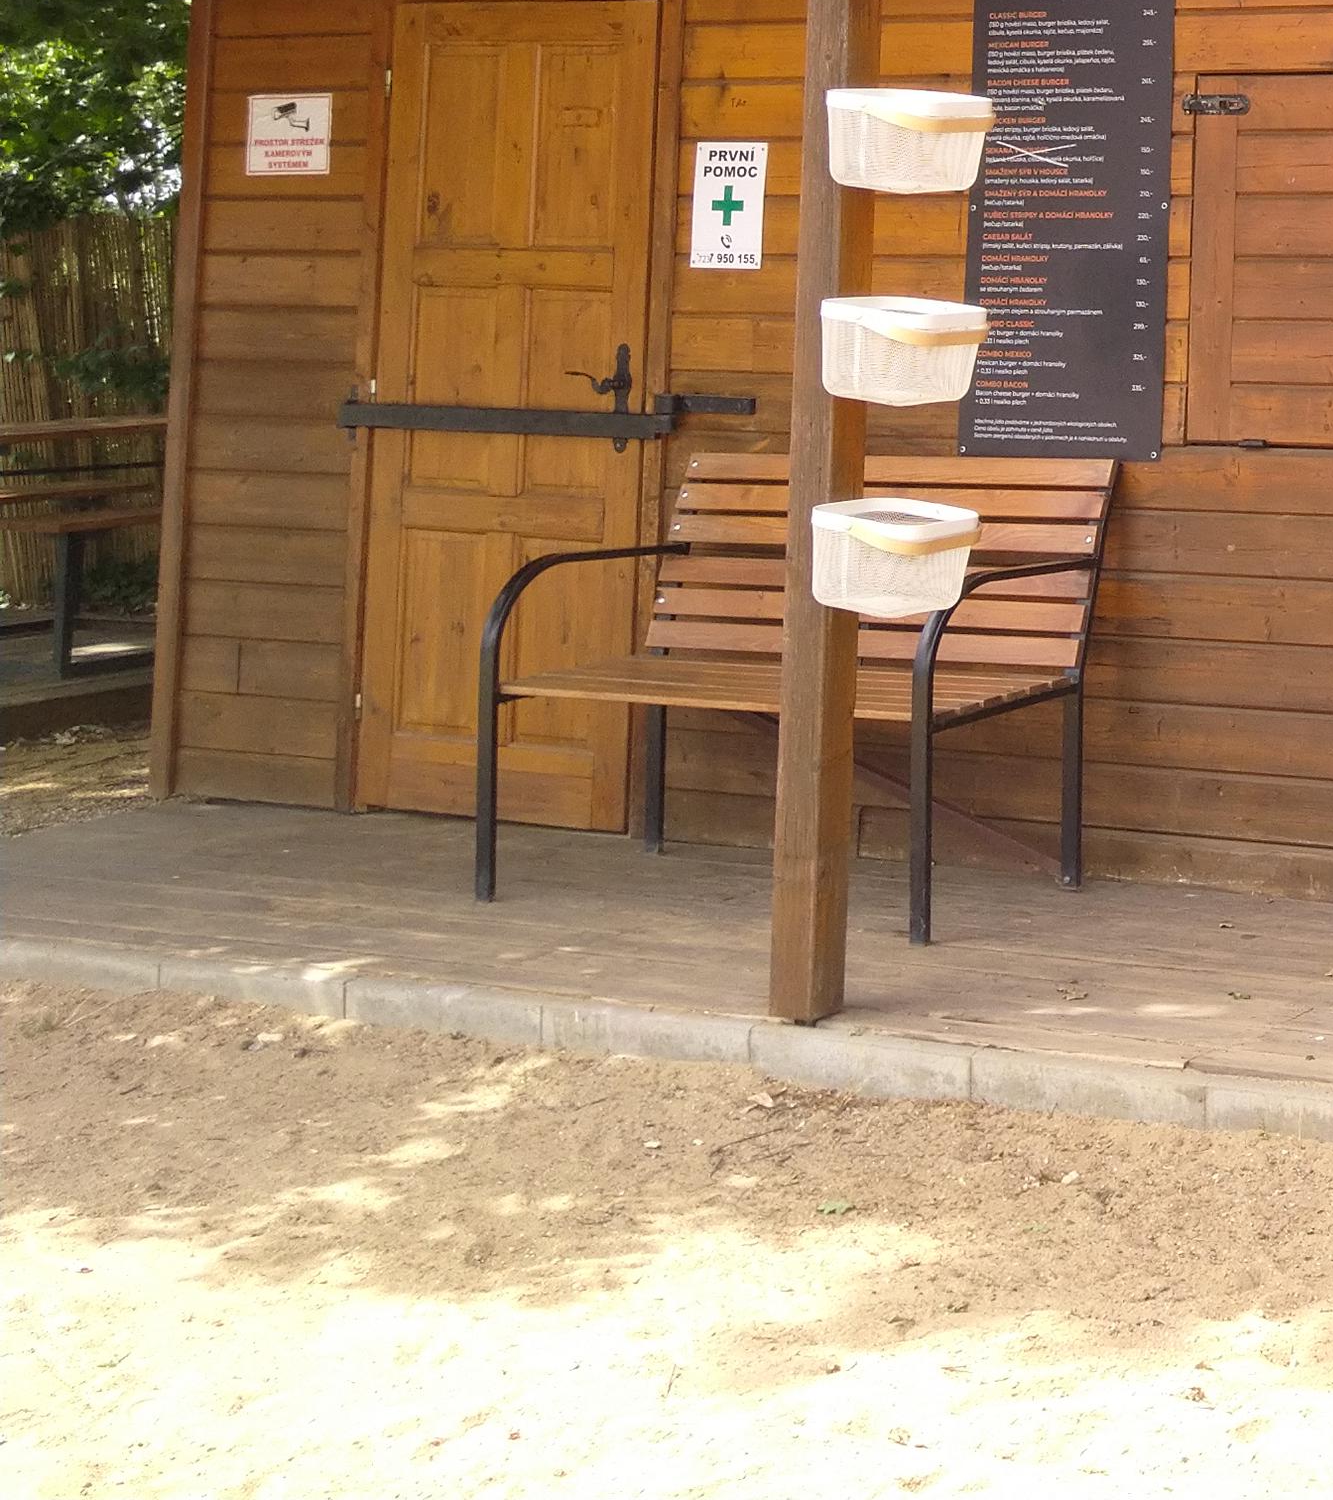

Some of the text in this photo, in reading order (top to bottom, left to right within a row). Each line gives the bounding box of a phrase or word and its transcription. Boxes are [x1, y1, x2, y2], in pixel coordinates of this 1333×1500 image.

[708, 146, 757, 162] PRVNÍ
[703, 165, 759, 178] POMOC
[716, 253, 735, 264] 950
[737, 253, 756, 265] 155
